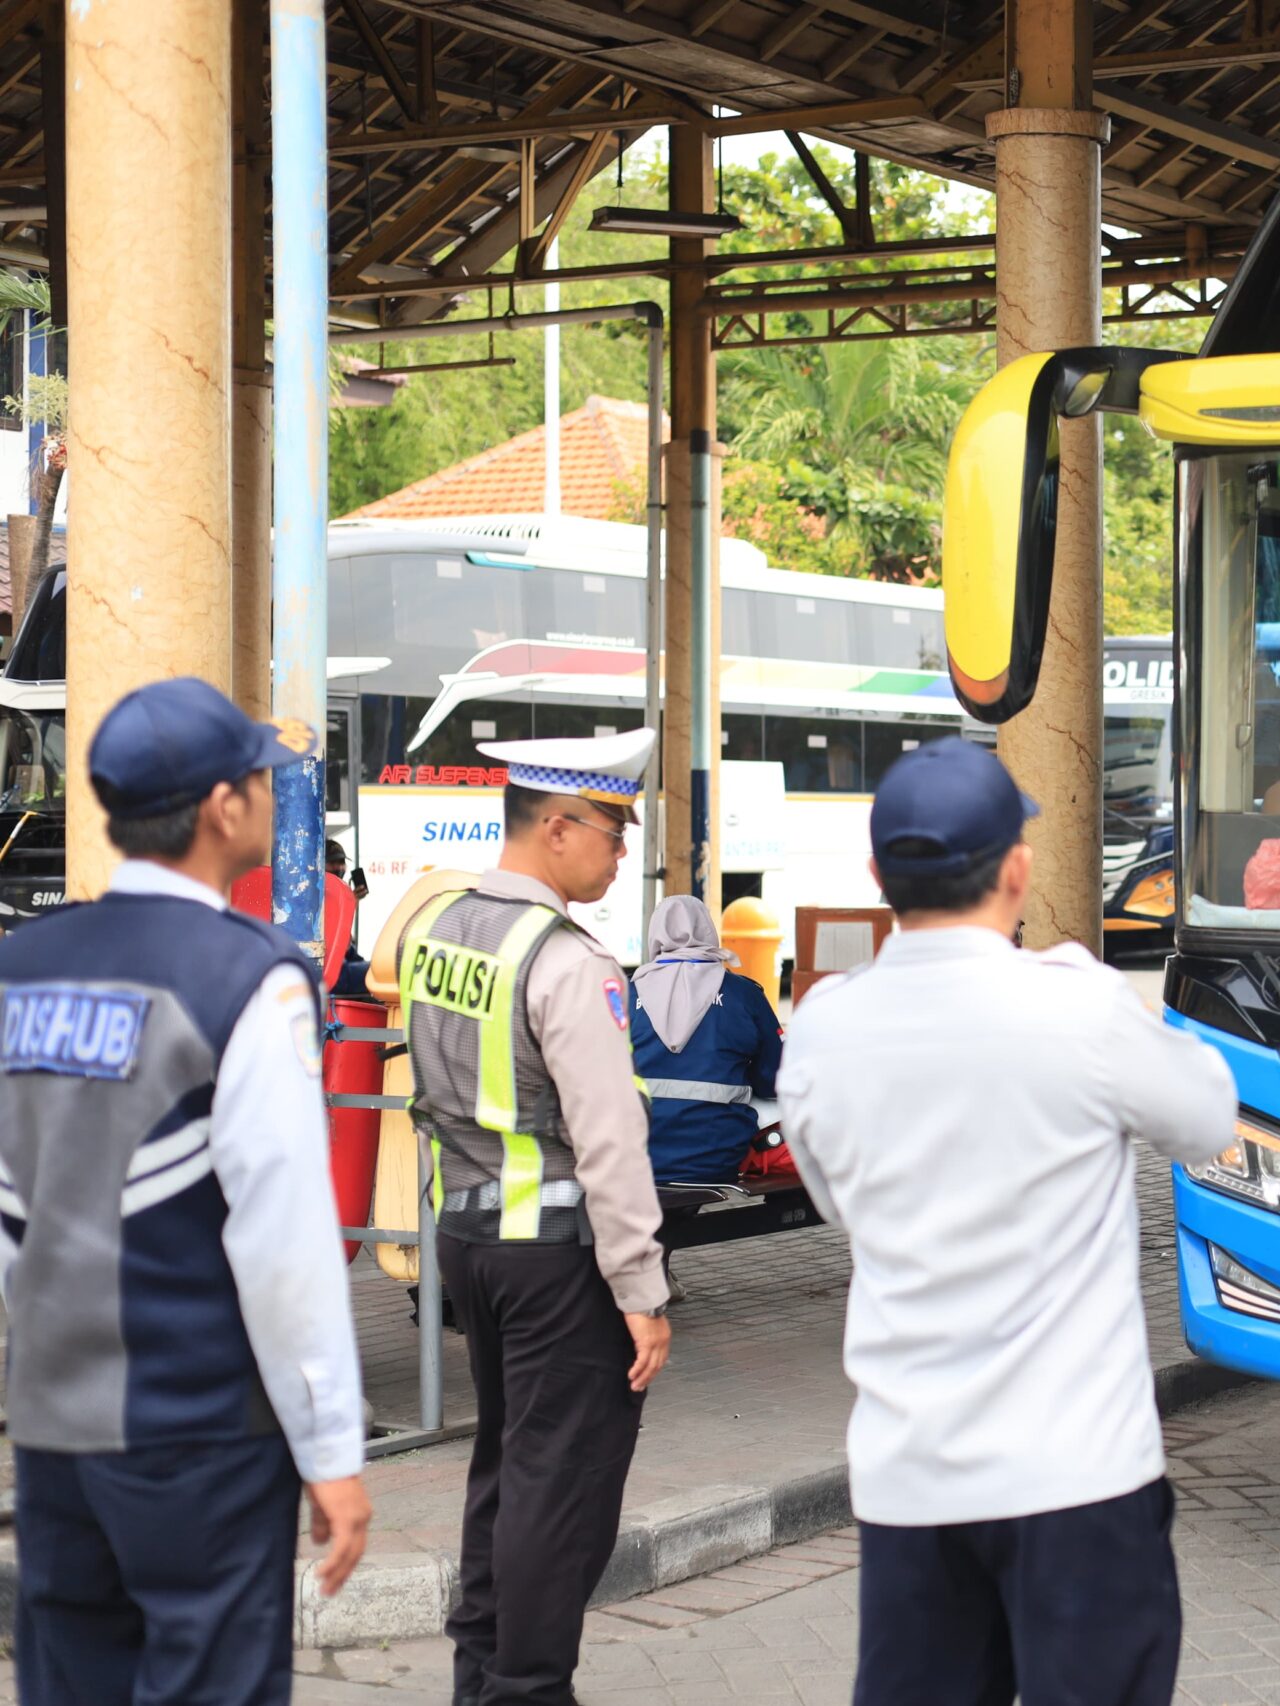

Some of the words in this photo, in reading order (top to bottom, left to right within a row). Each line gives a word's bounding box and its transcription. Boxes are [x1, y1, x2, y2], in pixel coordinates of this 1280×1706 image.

[379, 764, 412, 785] AIR
[422, 821, 501, 842] SINAR
[408, 944, 499, 1013] POLISI
[2, 994, 135, 1067] DISHUB
